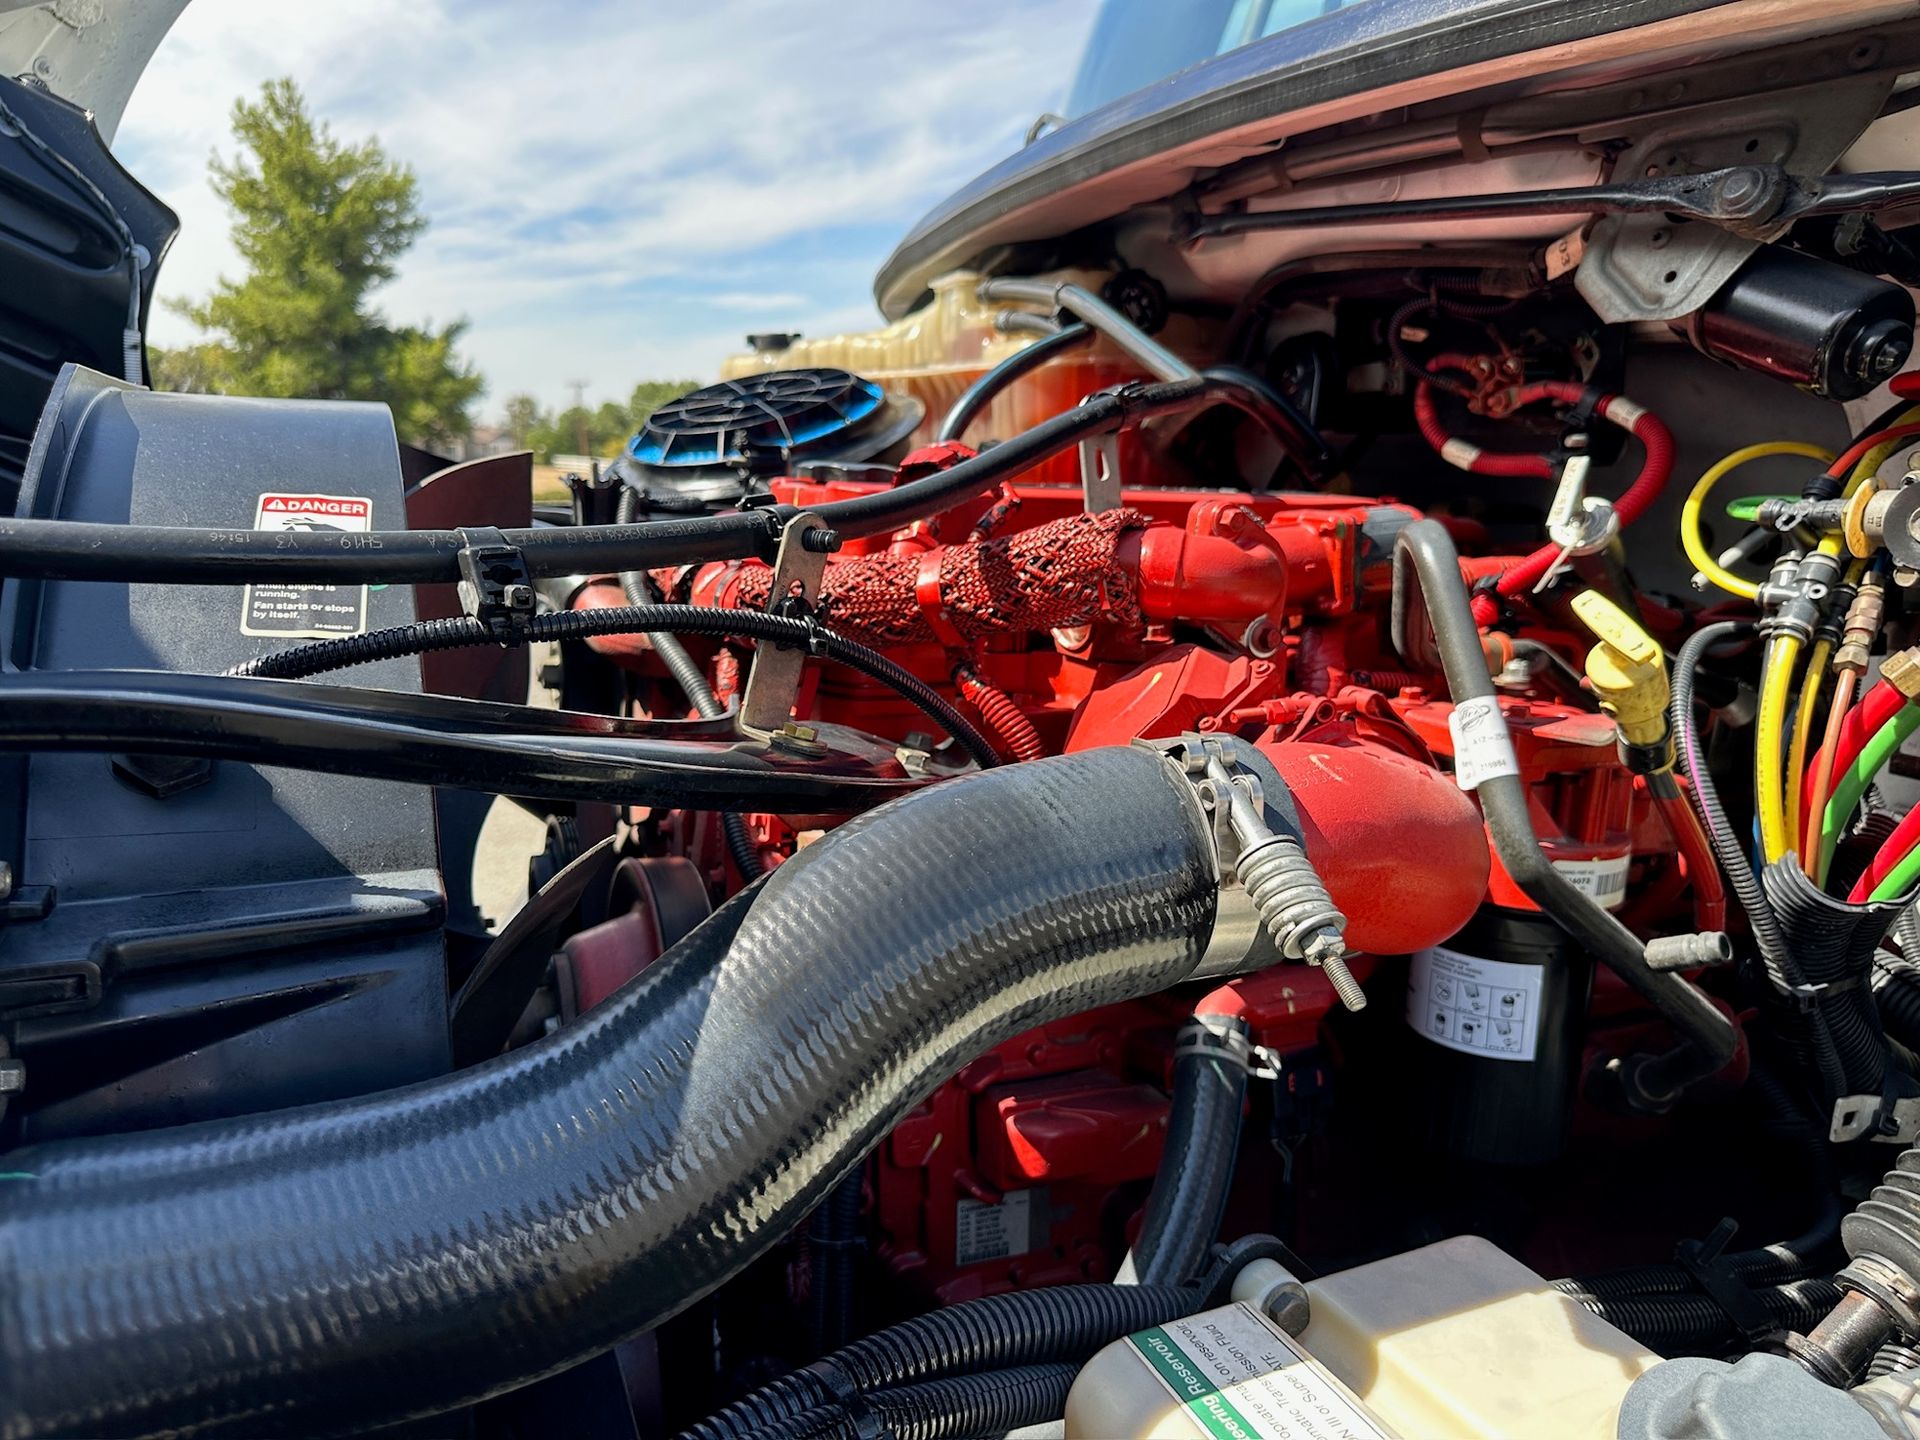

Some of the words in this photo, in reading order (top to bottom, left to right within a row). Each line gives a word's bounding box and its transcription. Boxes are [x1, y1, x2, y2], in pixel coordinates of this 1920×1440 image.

[288, 501, 365, 514] DANGER
[210, 532, 250, 544] 15:46
[275, 534, 298, 549] Y3
[255, 590, 300, 600] running.
[252, 611, 267, 619] by
[268, 611, 300, 619] itself.
[253, 601, 274, 610] Fan
[324, 604, 355, 614] stops
[1176, 1322, 1218, 1361] reservoir.
[1203, 1323, 1230, 1347] Fluid
[1146, 1337, 1206, 1395] Reservoir
[1214, 1361, 1230, 1376] on
[1260, 1352, 1286, 1371] ATF.
[1228, 1346, 1290, 1408] Transmission
[1227, 1376, 1256, 1402] mark
[1284, 1373, 1317, 1403] Super
[1313, 1404, 1330, 1415] or
